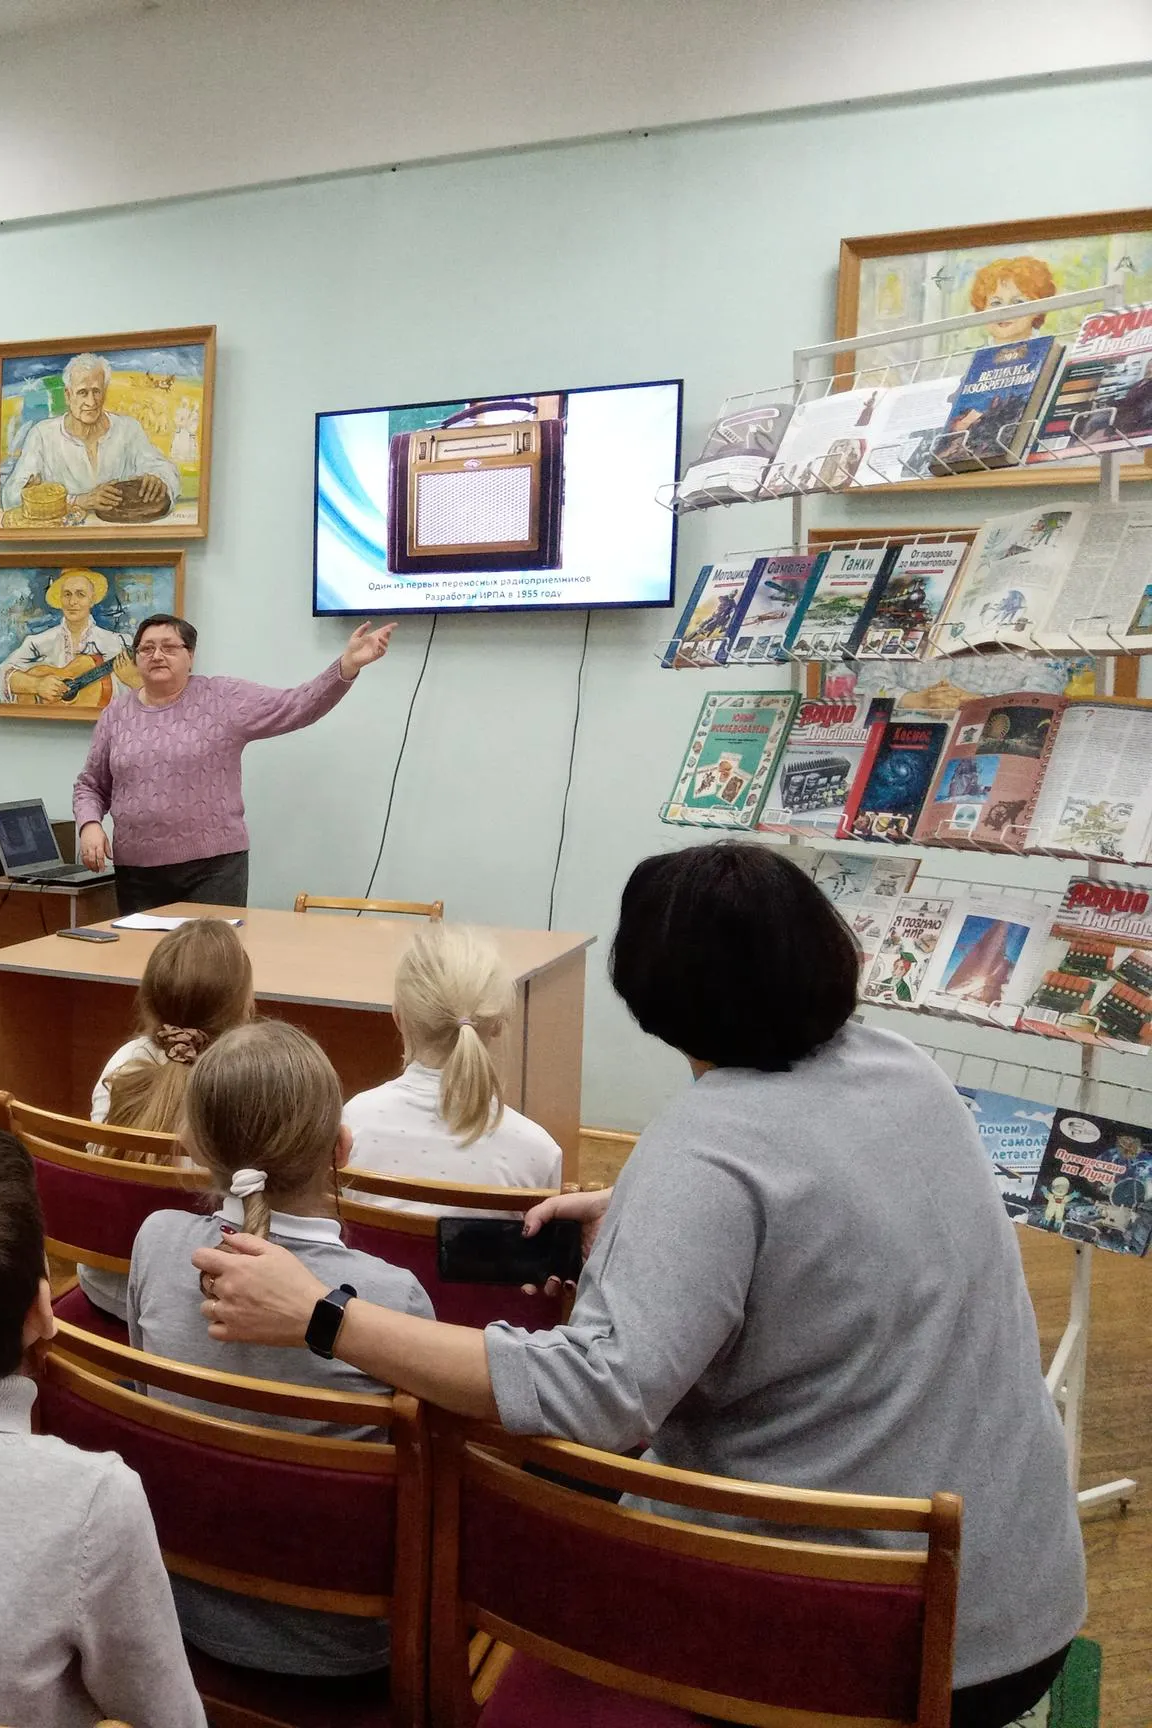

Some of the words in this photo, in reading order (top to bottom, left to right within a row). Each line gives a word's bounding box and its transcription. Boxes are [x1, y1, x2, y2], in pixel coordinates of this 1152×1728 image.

[978, 363, 1032, 382] ВЕЛИКИХ
[961, 370, 1039, 395] ИЗОБРЕТЕНИЙ
[911, 550, 920, 559] От
[921, 549, 954, 559] паровоза
[840, 554, 875, 572] Танки
[899, 560, 909, 569] до
[910, 558, 958, 569] магнитоплана
[368, 582, 392, 591] Один
[406, 580, 439, 590] первых
[442, 578, 498, 589] переносных
[500, 575, 591, 587] радиоприемников
[425, 591, 477, 602] Разработан
[479, 591, 505, 600] ИРПА
[516, 590, 538, 599] 1955
[540, 590, 562, 600] году
[893, 915, 902, 926] Я
[902, 917, 942, 930] ПОЗНАЮ
[902, 928, 924, 939] МИР
[978, 1124, 1028, 1136] Почему
[991, 1148, 1042, 1160] летает?
[1056, 1148, 1126, 1173] Путешествие
[1062, 1164, 1078, 1175] на
[1079, 1164, 1118, 1185] Луну
